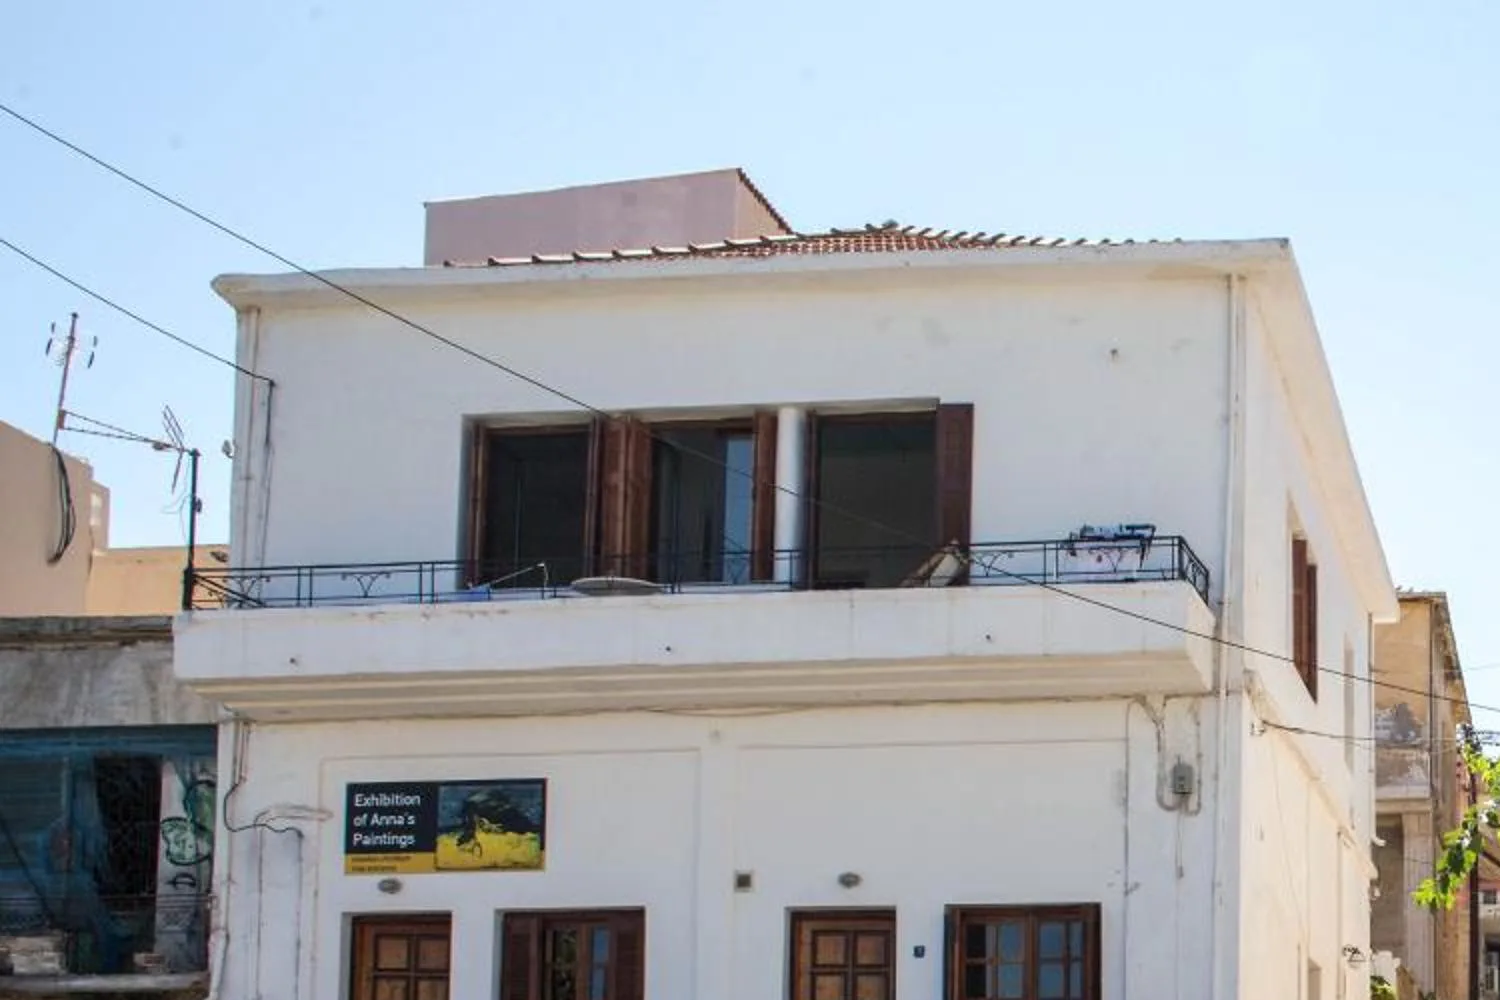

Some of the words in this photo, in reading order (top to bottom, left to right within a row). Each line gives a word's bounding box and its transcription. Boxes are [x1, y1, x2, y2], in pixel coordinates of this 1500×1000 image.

[354, 793, 421, 807] Exhibition
[353, 814, 368, 826] of
[370, 813, 416, 825] Anna's
[353, 833, 415, 848] Paintings
